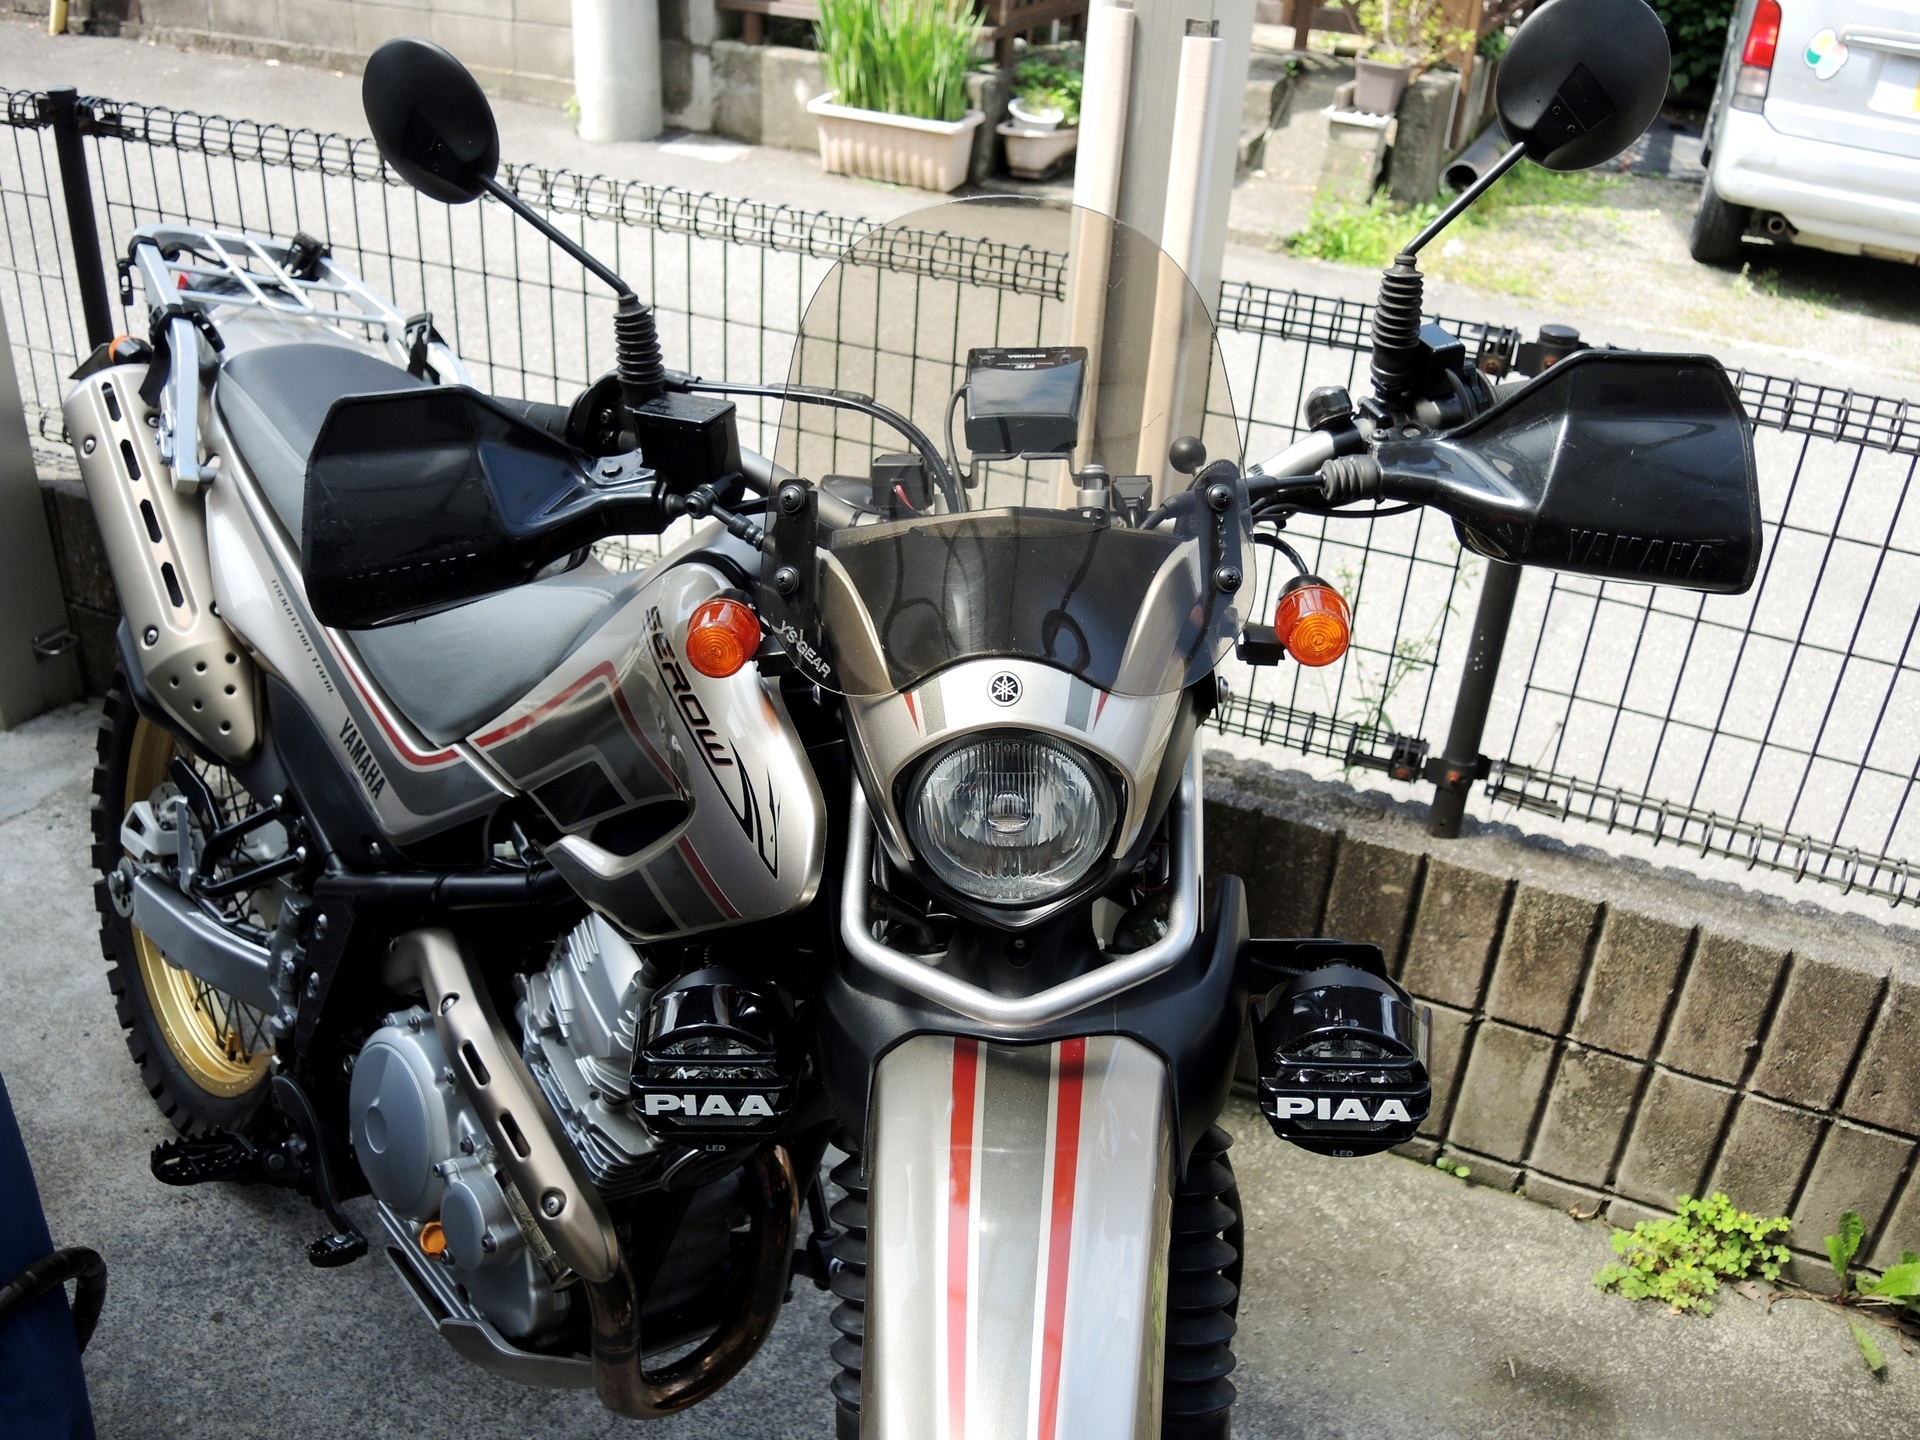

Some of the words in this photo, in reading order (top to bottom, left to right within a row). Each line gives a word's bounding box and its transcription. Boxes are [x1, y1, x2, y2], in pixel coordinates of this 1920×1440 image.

[1567, 528, 1713, 578] YAMAHA
[272, 579, 312, 652] MOUNTAIN
[311, 657, 334, 697] TRAIL
[645, 605, 734, 766] SEROW
[338, 717, 386, 800] YAMAHA
[994, 742, 1021, 753] TOP
[644, 1094, 775, 1116] PIAA
[1276, 1097, 1412, 1122] PIAA
[705, 1144, 726, 1152] LED
[1332, 1149, 1354, 1157] LED
